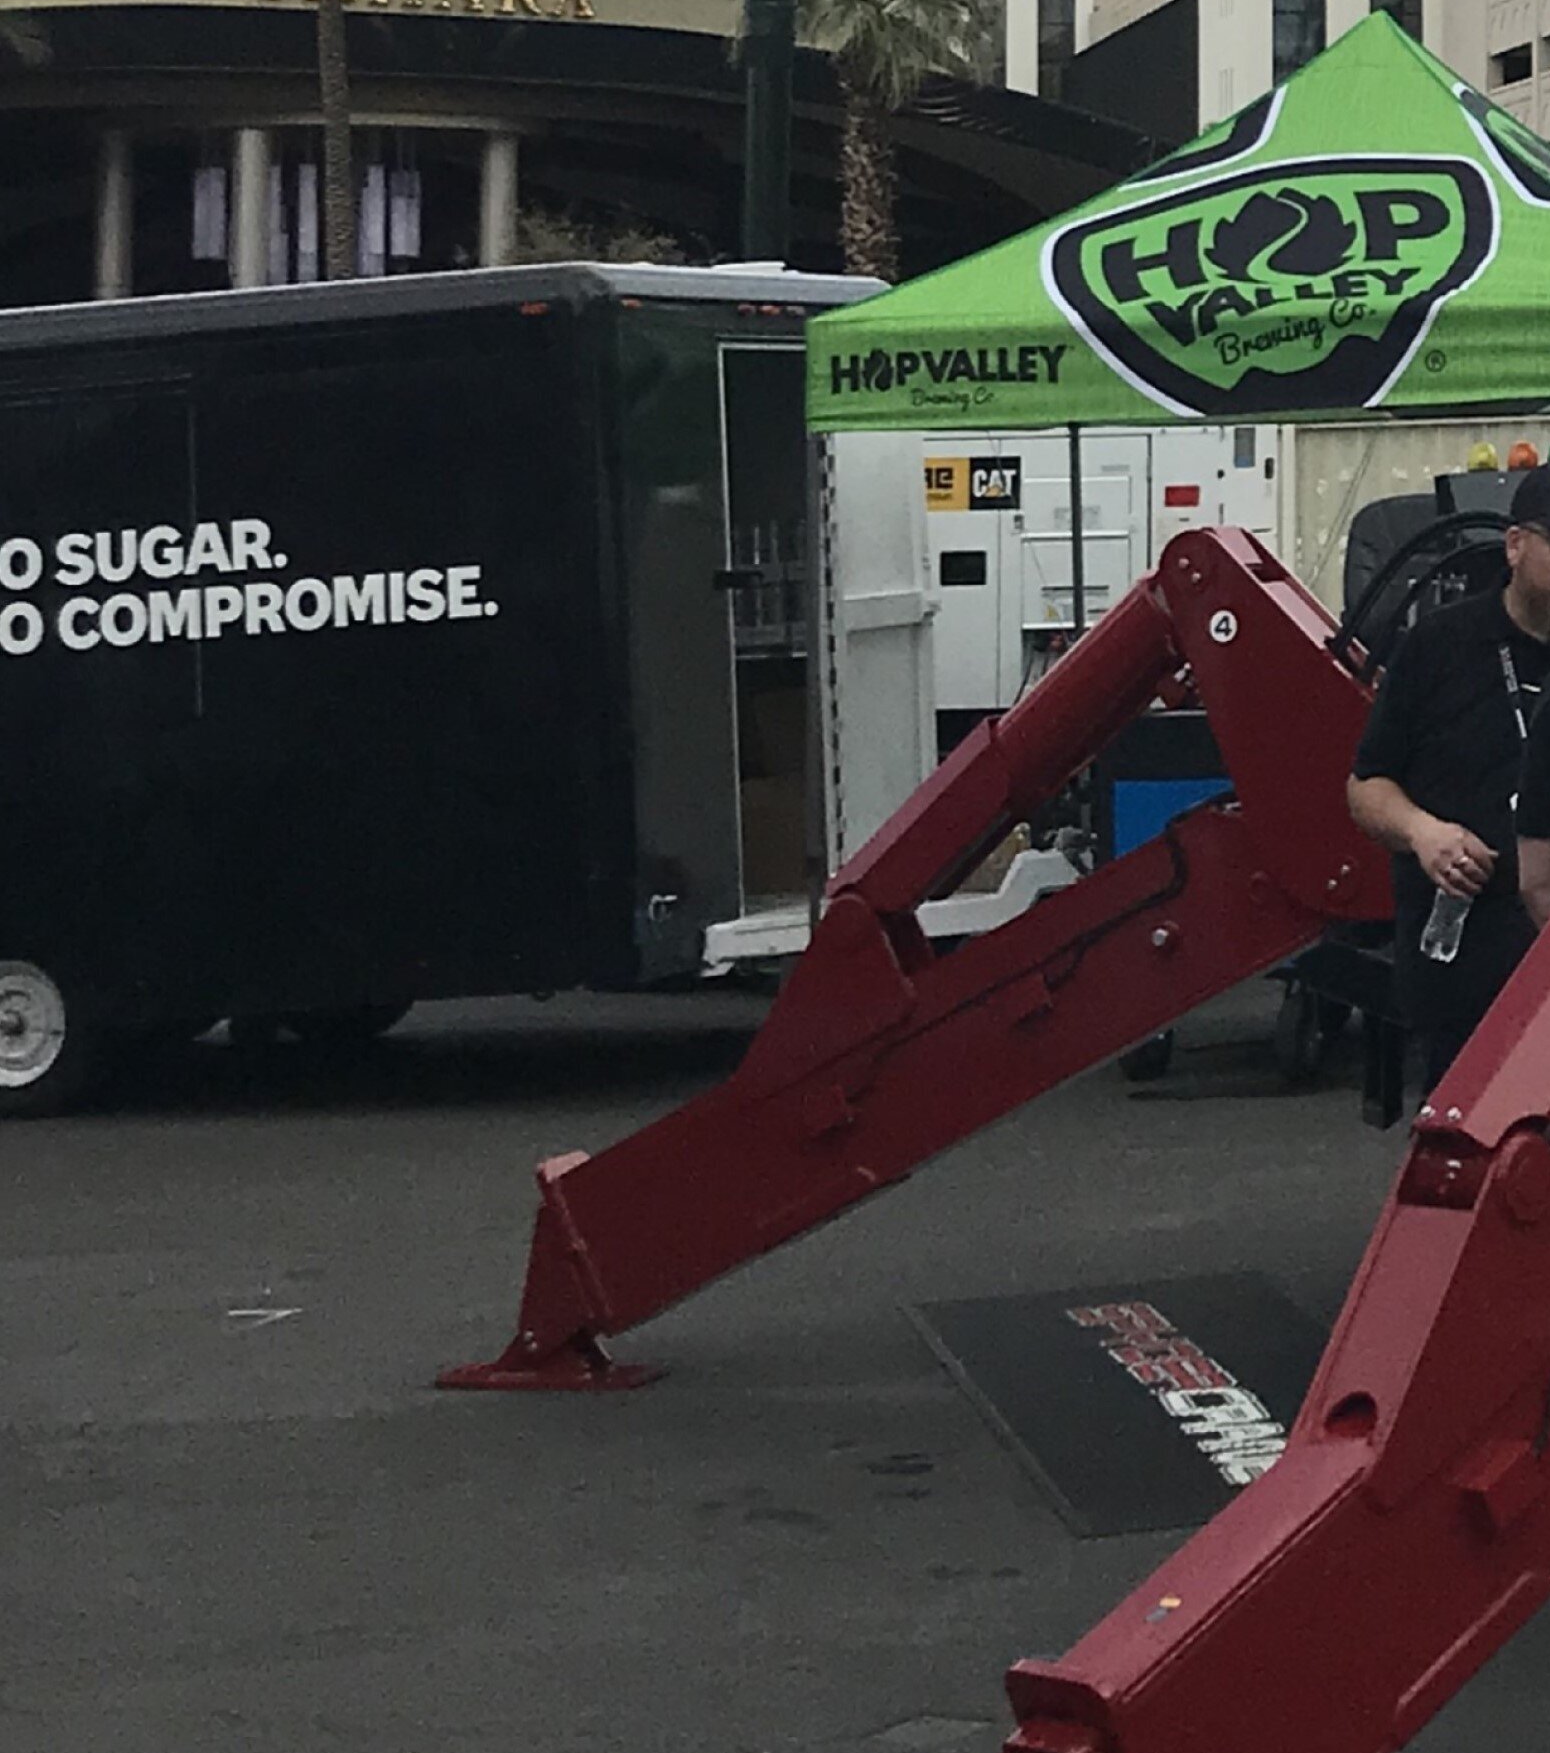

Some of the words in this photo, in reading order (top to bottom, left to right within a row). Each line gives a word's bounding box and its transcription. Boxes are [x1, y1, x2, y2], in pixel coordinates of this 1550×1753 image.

[1101, 187, 1451, 304] HOP
[1144, 266, 1422, 347] VALLEY
[1213, 314, 1325, 366] Brewing
[972, 468, 1017, 497] CAT
[55, 518, 288, 586] SUGAR.
[58, 565, 499, 651] COMPROMISE.
